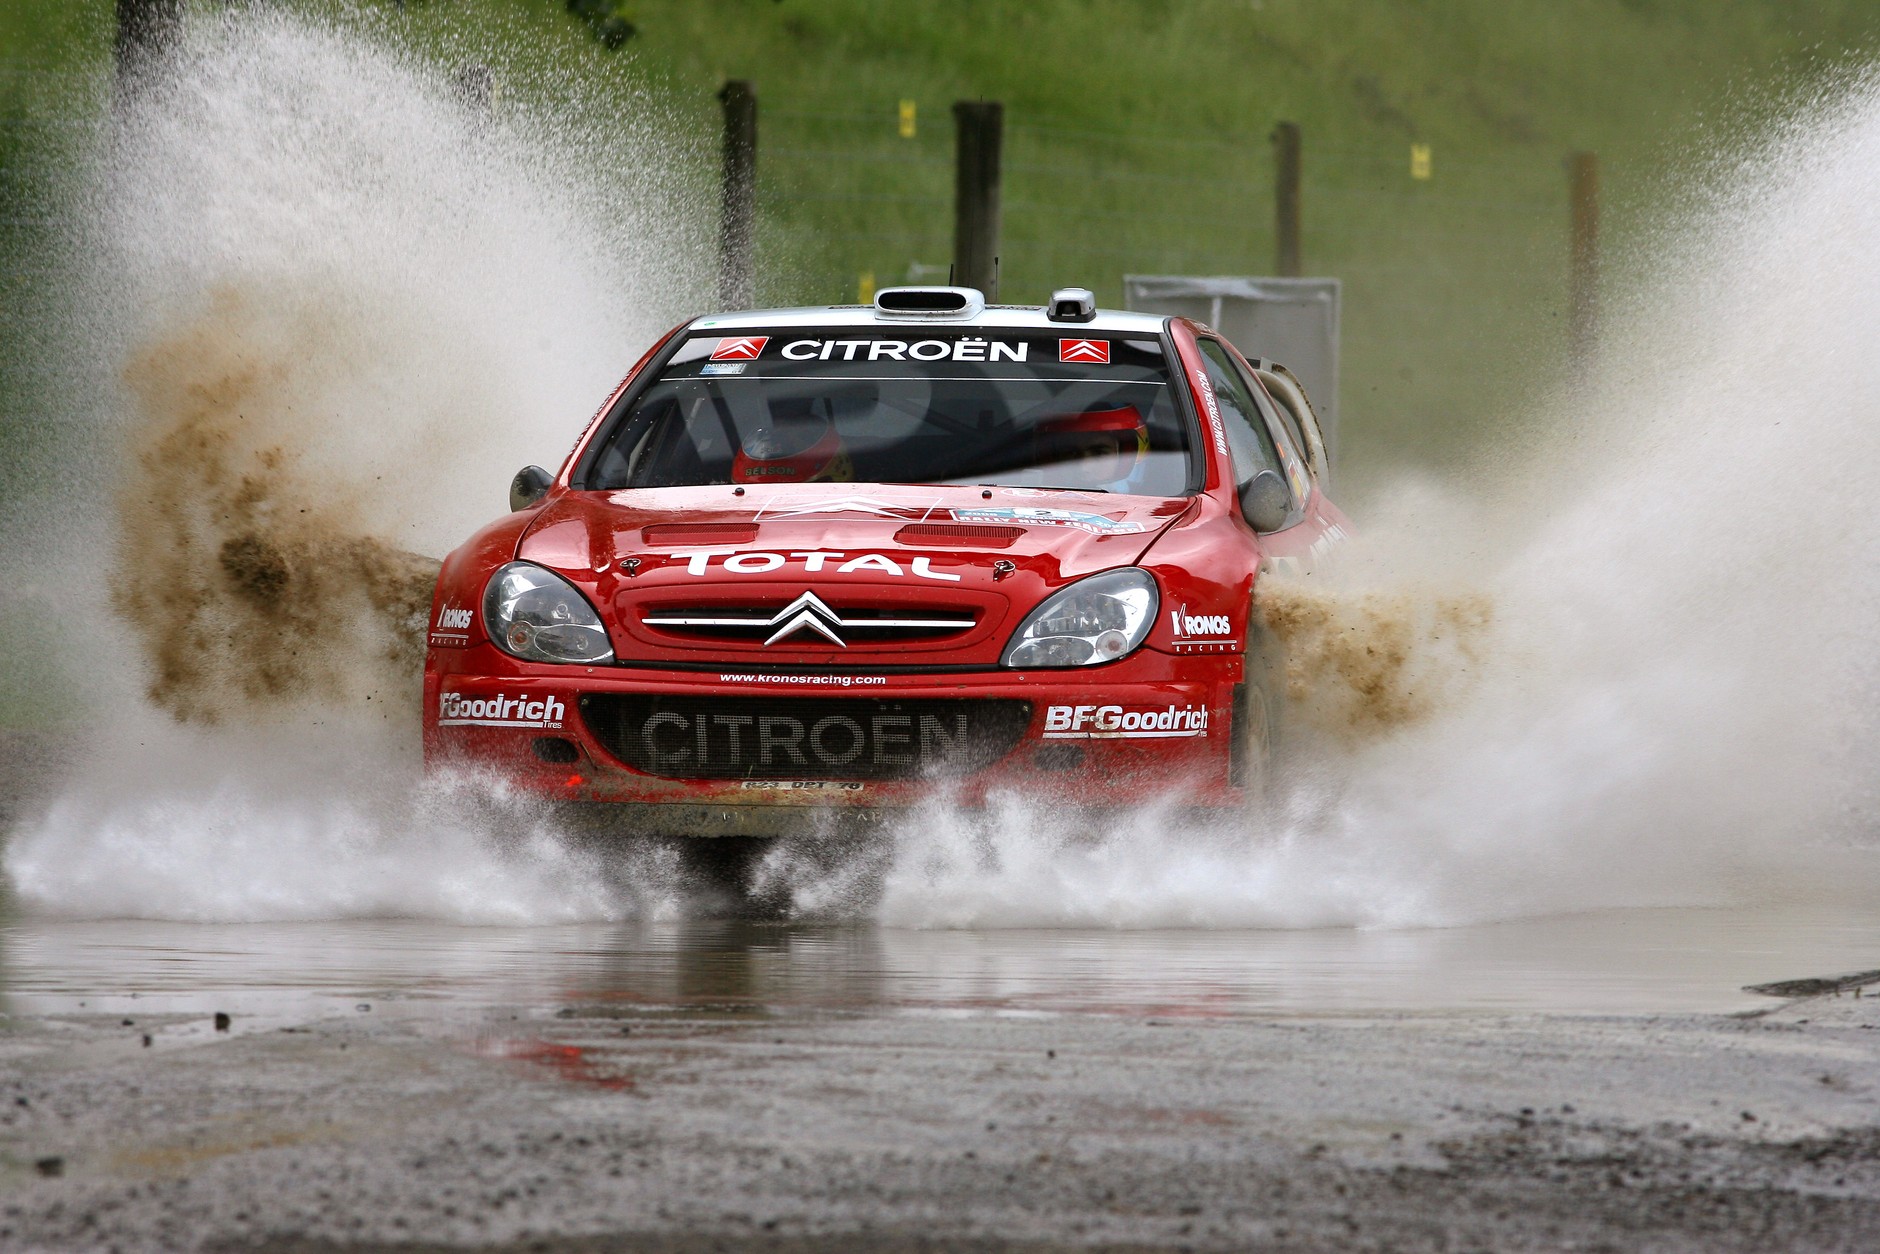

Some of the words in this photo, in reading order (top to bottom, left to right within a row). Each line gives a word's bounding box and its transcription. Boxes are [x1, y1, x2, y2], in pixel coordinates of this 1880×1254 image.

[781, 337, 1028, 362] CITROËN
[1196, 370, 1228, 456] WWW.CITROEN.COM
[670, 550, 961, 582] TOTAL
[1171, 603, 1231, 638] KRONOS
[720, 674, 886, 686] www.kronosracing.com
[440, 692, 565, 720] FGoodrich
[1044, 704, 1208, 730] BFGoodrich
[543, 720, 562, 728] Tires
[641, 704, 967, 766] CITROËN
